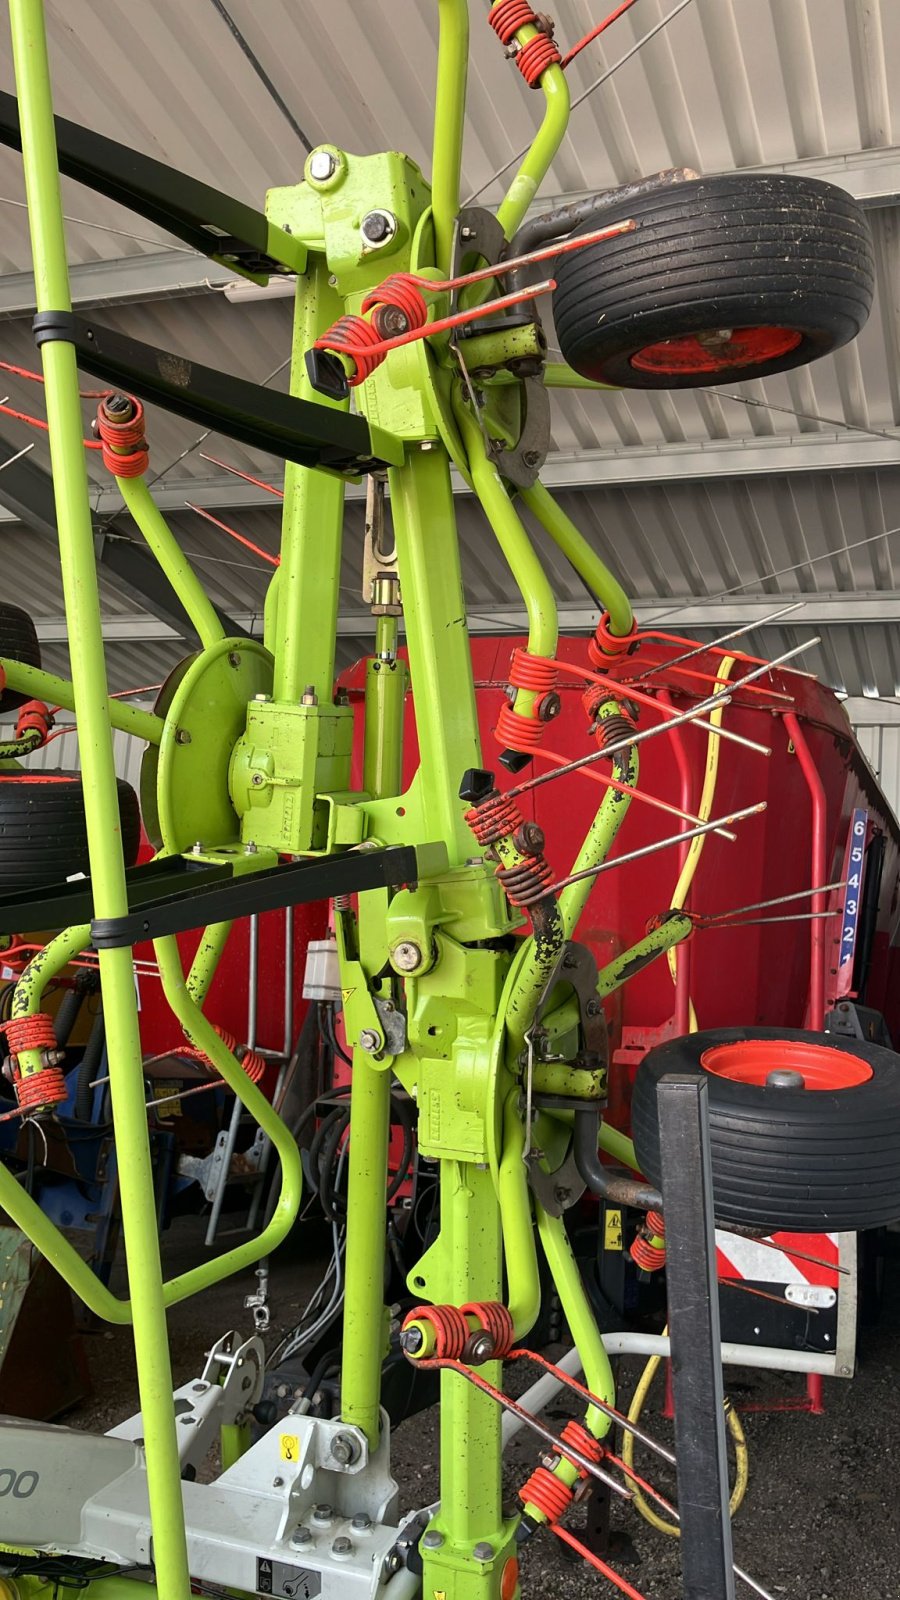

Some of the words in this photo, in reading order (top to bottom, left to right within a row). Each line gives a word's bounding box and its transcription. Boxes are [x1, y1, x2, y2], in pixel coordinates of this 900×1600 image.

[854, 821, 865, 836] 6
[851, 848, 862, 862] 5
[848, 873, 859, 888] 4
[846, 900, 857, 915] 3
[843, 927, 854, 942] 2
